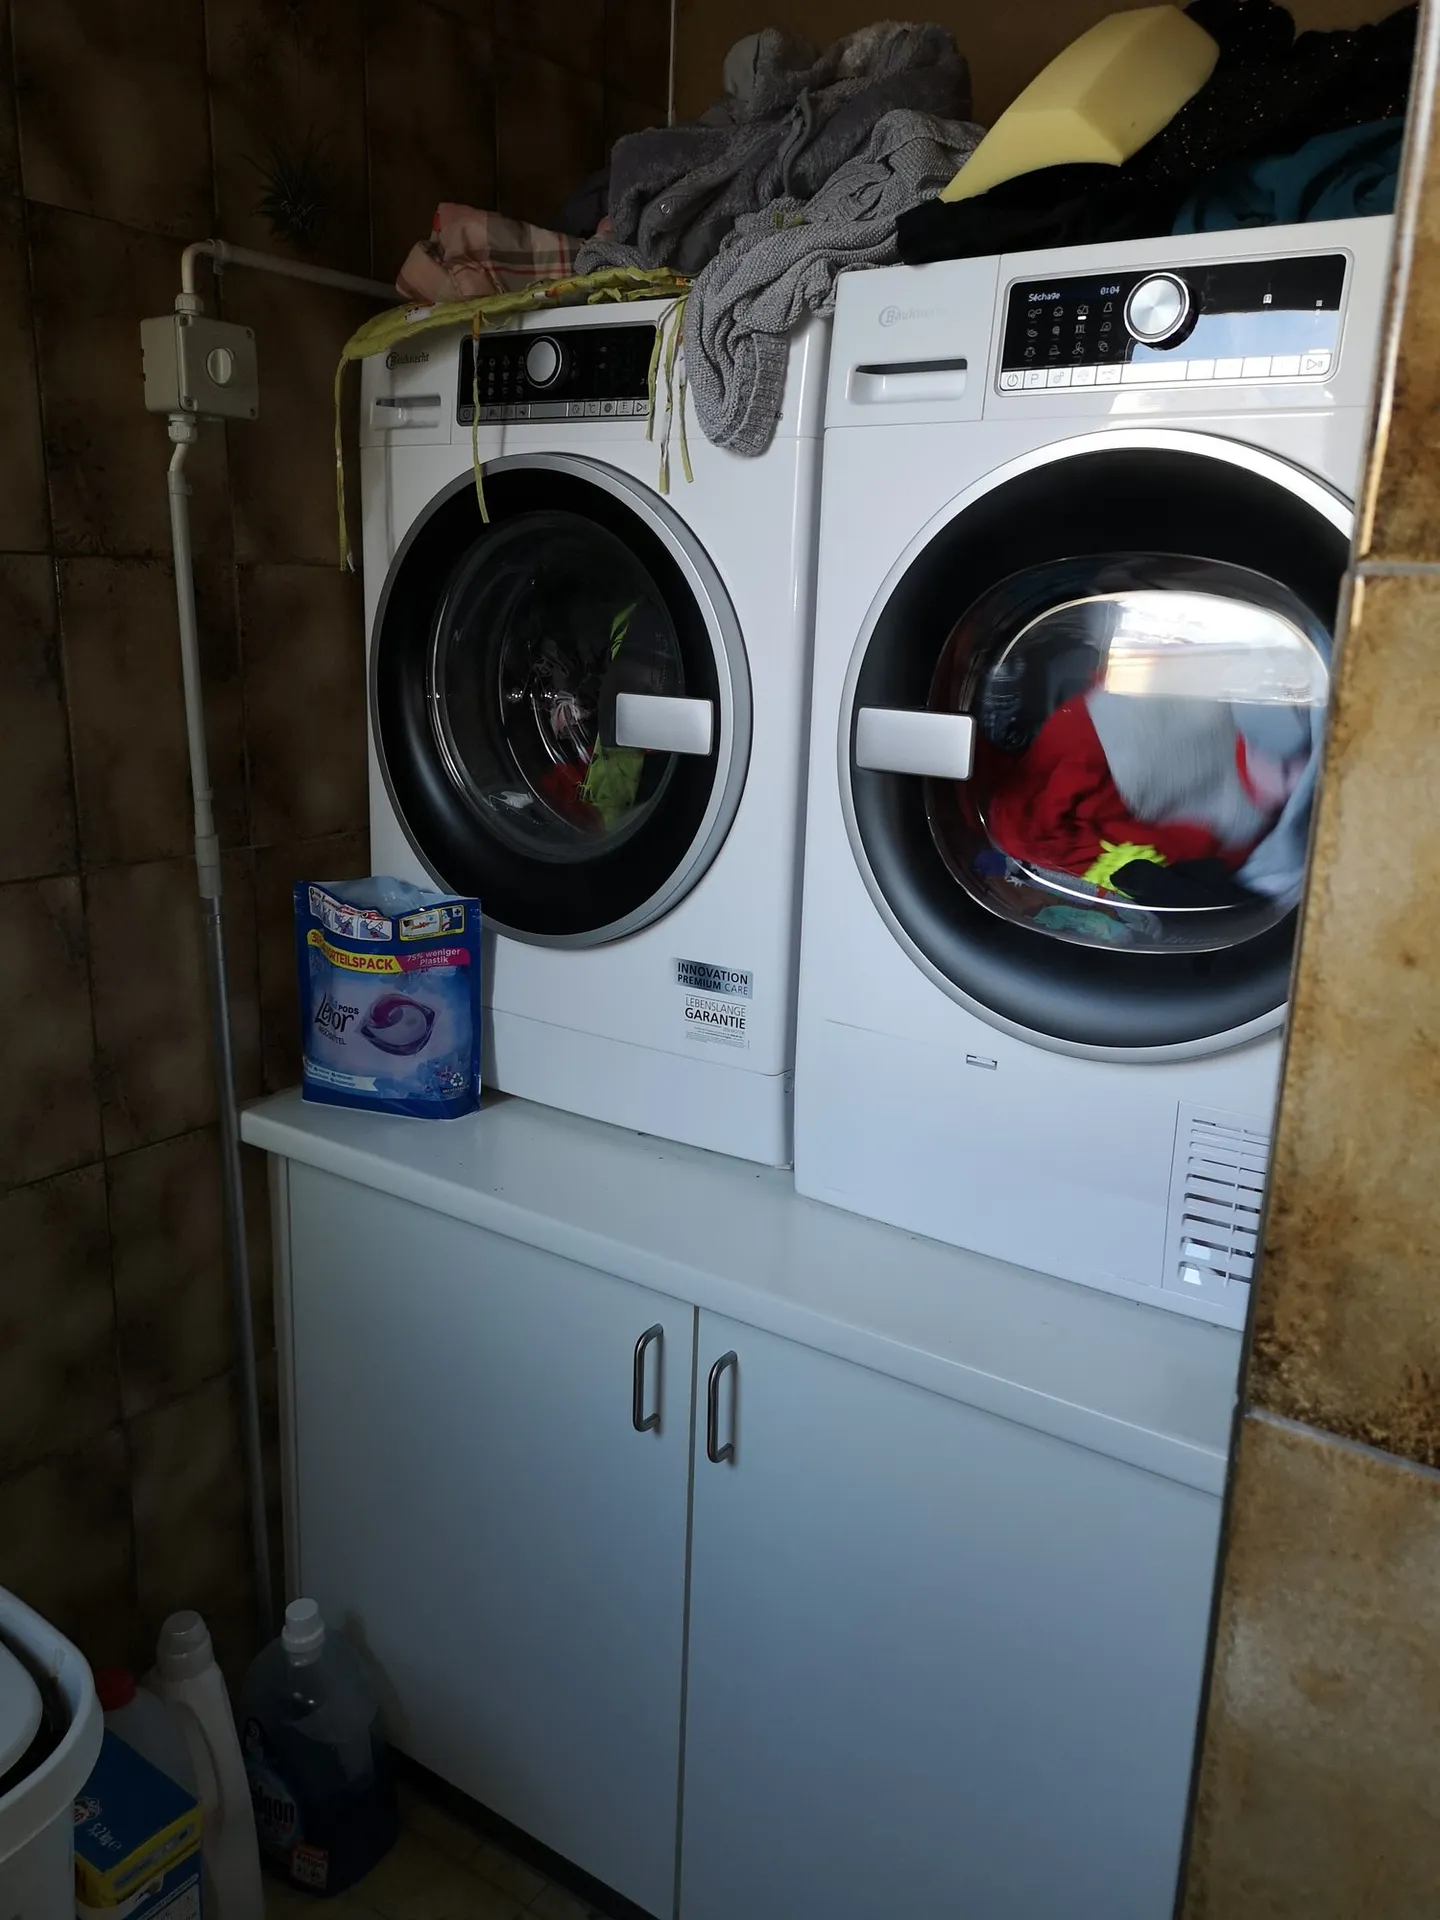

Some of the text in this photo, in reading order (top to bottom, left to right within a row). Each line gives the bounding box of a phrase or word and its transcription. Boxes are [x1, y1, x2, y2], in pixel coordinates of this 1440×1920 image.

[1100, 286, 1120, 295] 0:04
[322, 945, 394, 970] ORTEILSPACK
[419, 956, 449, 966] Plastik
[425, 948, 461, 958] weniger
[677, 962, 748, 985] INNOVATION
[677, 974, 748, 995] PREMIUM CARE
[338, 1004, 360, 1015] PODS
[685, 996, 746, 1017] LEBENSLANGE
[684, 1007, 746, 1029] GARANTIE
